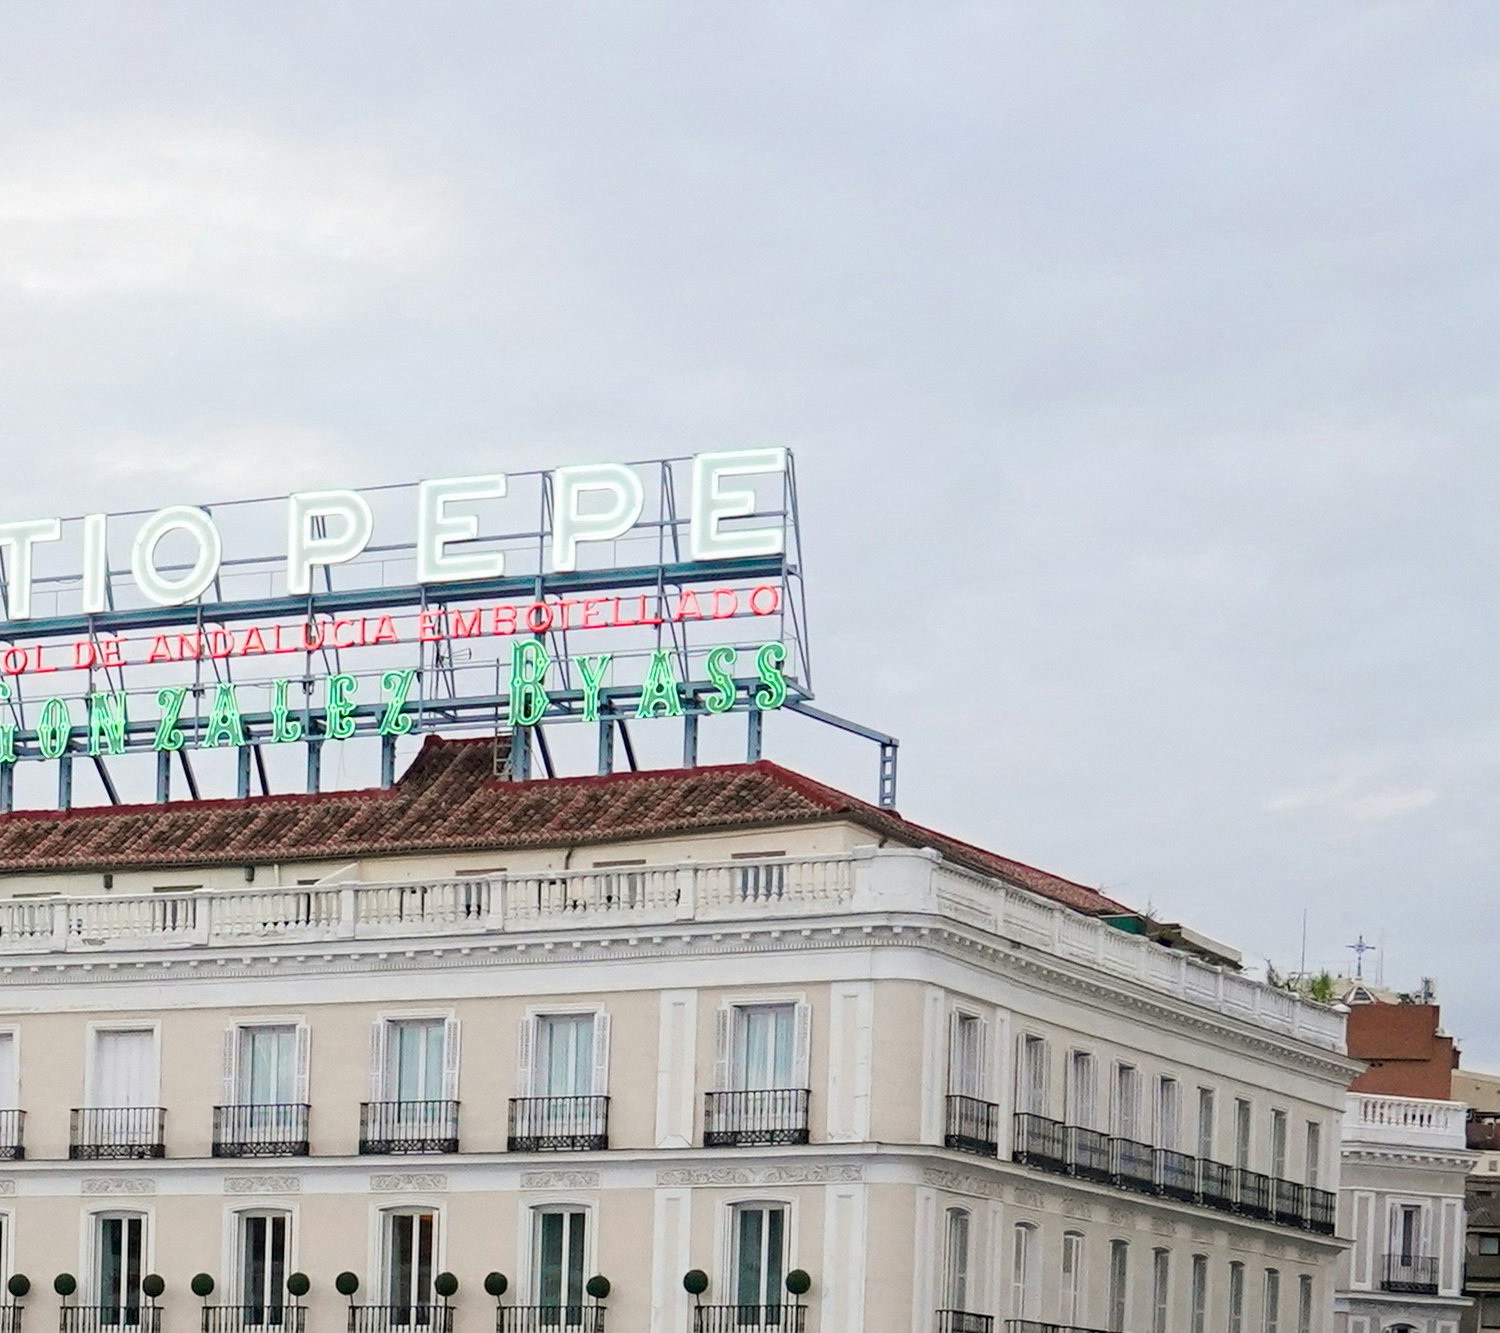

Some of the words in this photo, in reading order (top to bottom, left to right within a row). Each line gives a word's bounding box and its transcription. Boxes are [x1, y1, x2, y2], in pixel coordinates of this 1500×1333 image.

[287, 447, 787, 595] PEPE
[75, 637, 126, 669] DE
[147, 614, 400, 664] ANDALUCIA
[507, 640, 788, 727] BYASS
